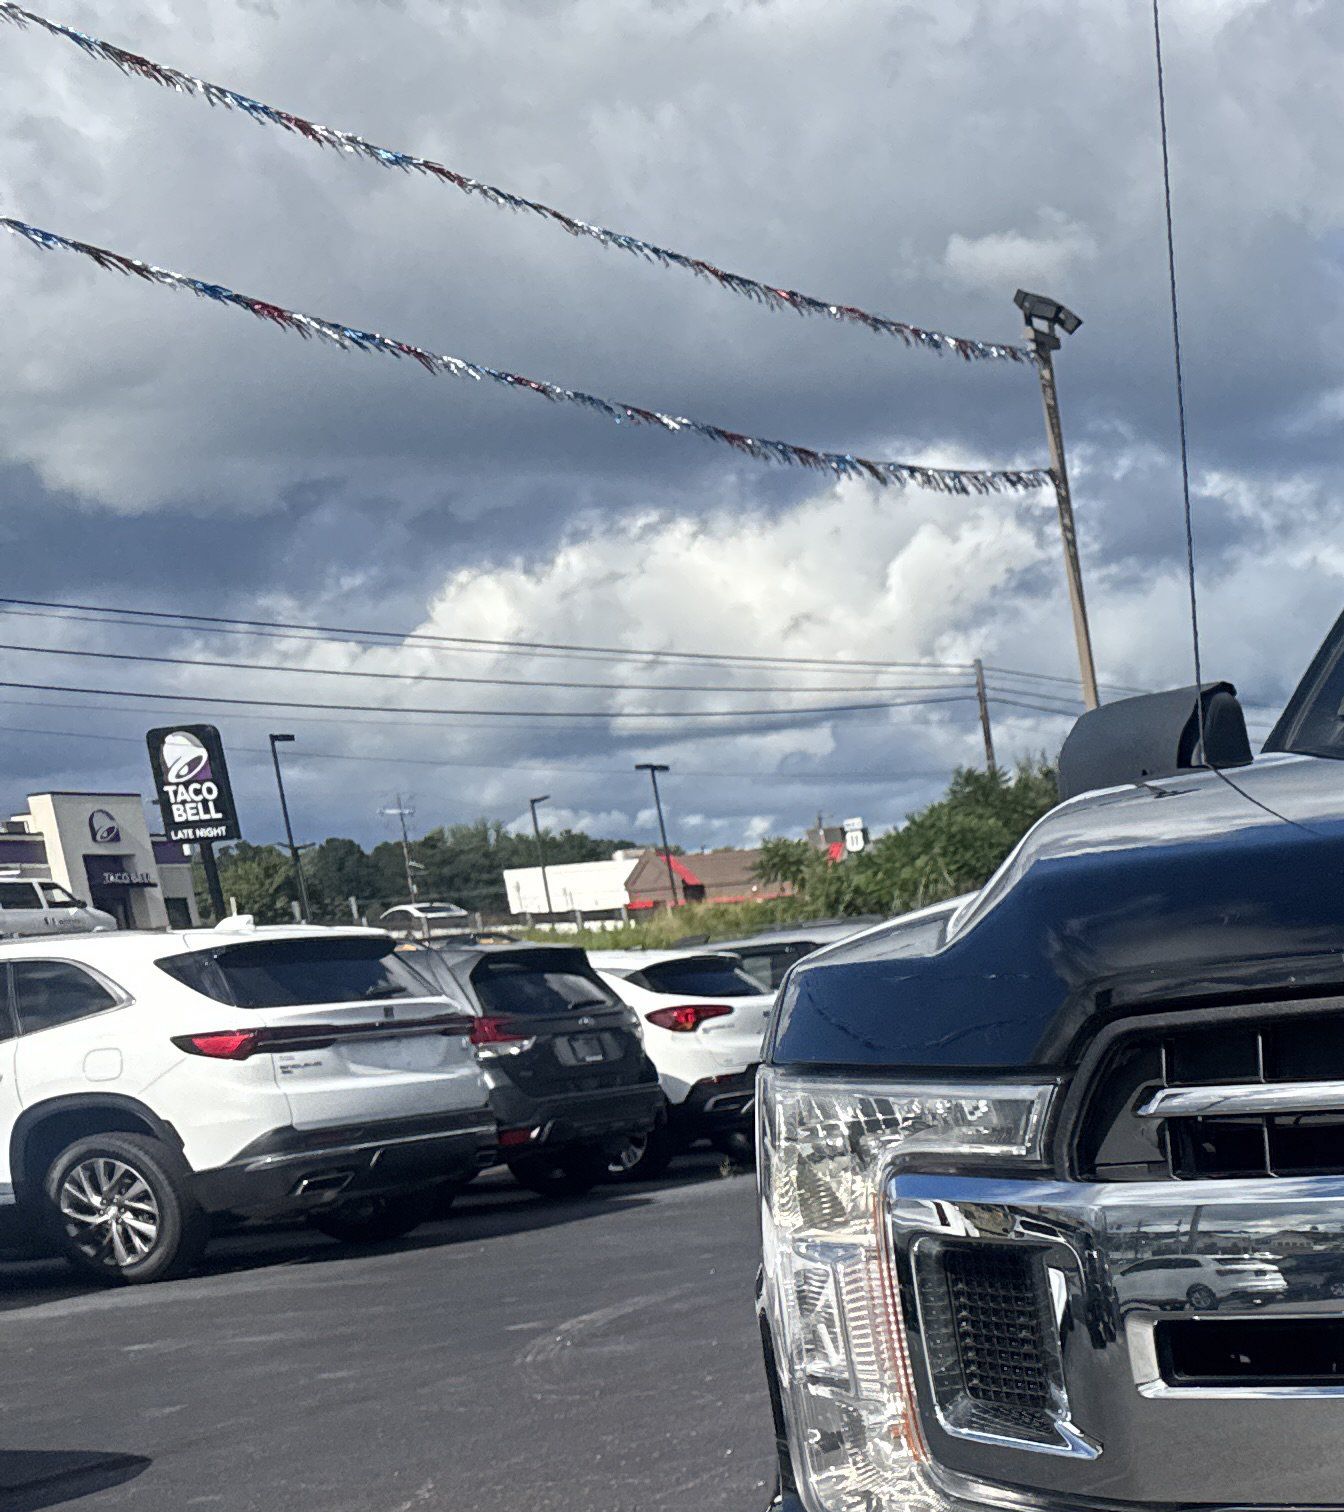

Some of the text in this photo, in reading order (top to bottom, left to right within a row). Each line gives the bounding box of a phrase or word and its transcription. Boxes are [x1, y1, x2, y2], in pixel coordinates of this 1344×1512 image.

[163, 781, 218, 803] TACO
[171, 801, 223, 822] BELL
[170, 825, 226, 840] LATE NIGHT
